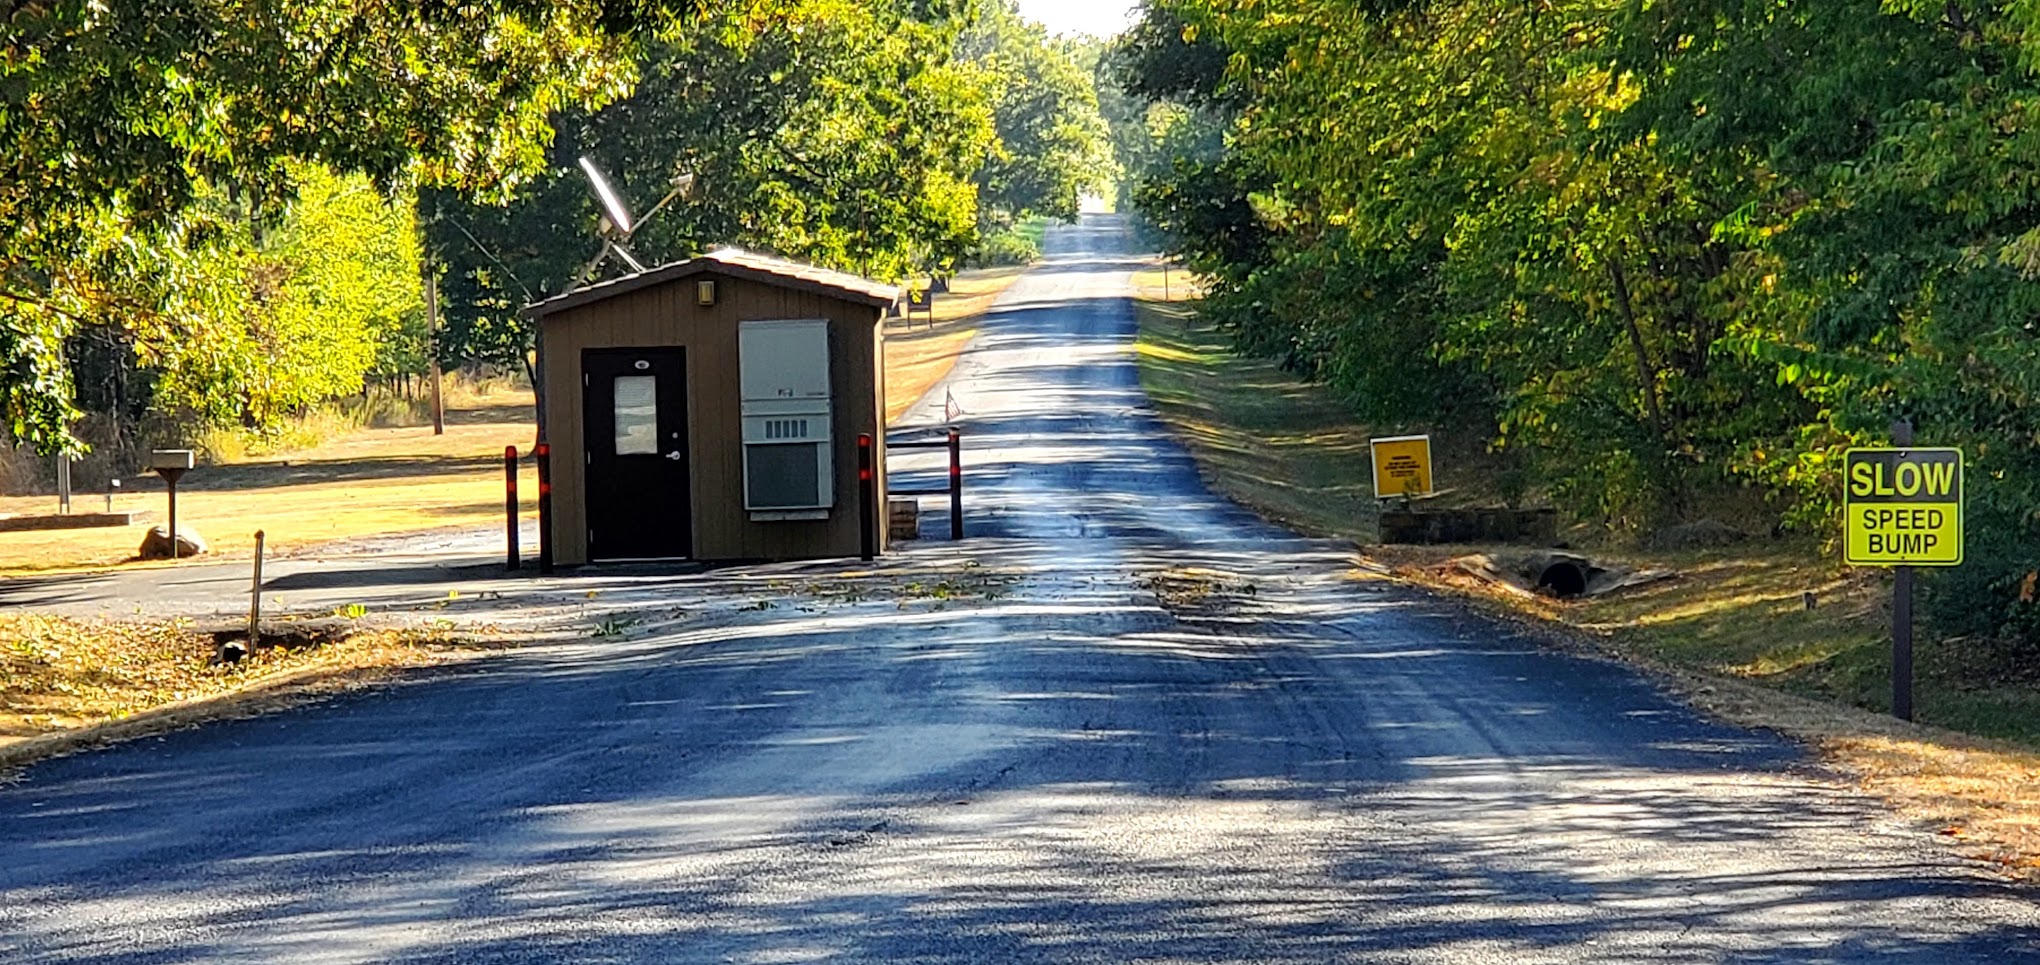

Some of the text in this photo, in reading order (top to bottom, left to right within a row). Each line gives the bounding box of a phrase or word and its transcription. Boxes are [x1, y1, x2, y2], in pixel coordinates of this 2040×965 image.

[1851, 461, 1955, 496] SLOW
[1863, 509, 1943, 529] SPEED
[1869, 533, 1937, 554] BUMP
